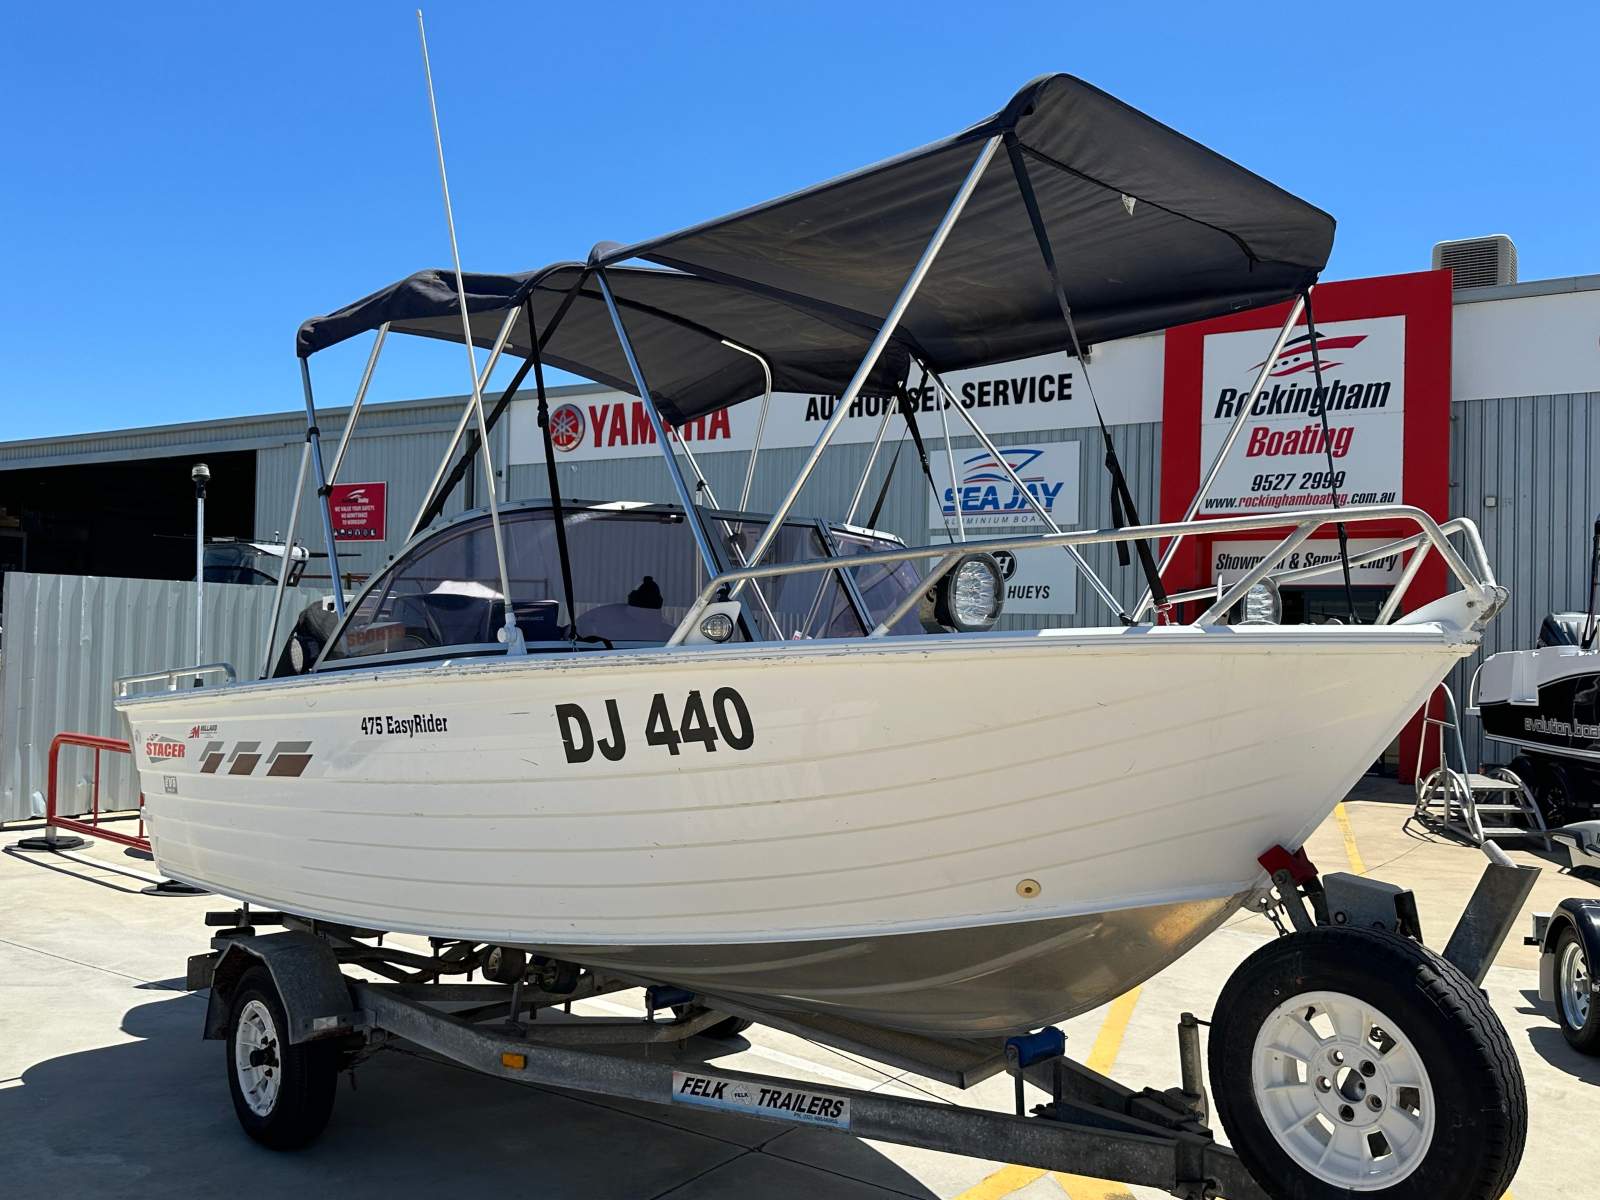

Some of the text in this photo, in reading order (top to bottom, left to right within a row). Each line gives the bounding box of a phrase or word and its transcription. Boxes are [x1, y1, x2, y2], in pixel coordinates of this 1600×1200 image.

[804, 373, 1073, 421] AUHORSED SERVICE
[1214, 380, 1391, 419] Rockingham
[588, 400, 732, 448] YAMHA
[1245, 423, 1355, 458] Boating
[1251, 470, 1346, 492] 9527 2999
[943, 482, 1064, 512] SEA JAY
[1205, 491, 1396, 508] www.rockinghamboatng.com.au
[945, 515, 1051, 525] ALMINIUM BOA
[1216, 553, 1286, 570] Showrm
[1289, 552, 1300, 570] &
[1303, 552, 1353, 569] Serv
[1007, 585, 1050, 599] HUEYS
[361, 713, 448, 738] 475 EasyRider
[555, 686, 755, 764] DJ 440
[1573, 718, 1600, 739] boa
[146, 742, 186, 758] STACER
[680, 1077, 729, 1100] FELK
[757, 1088, 844, 1119] TRAILERS
